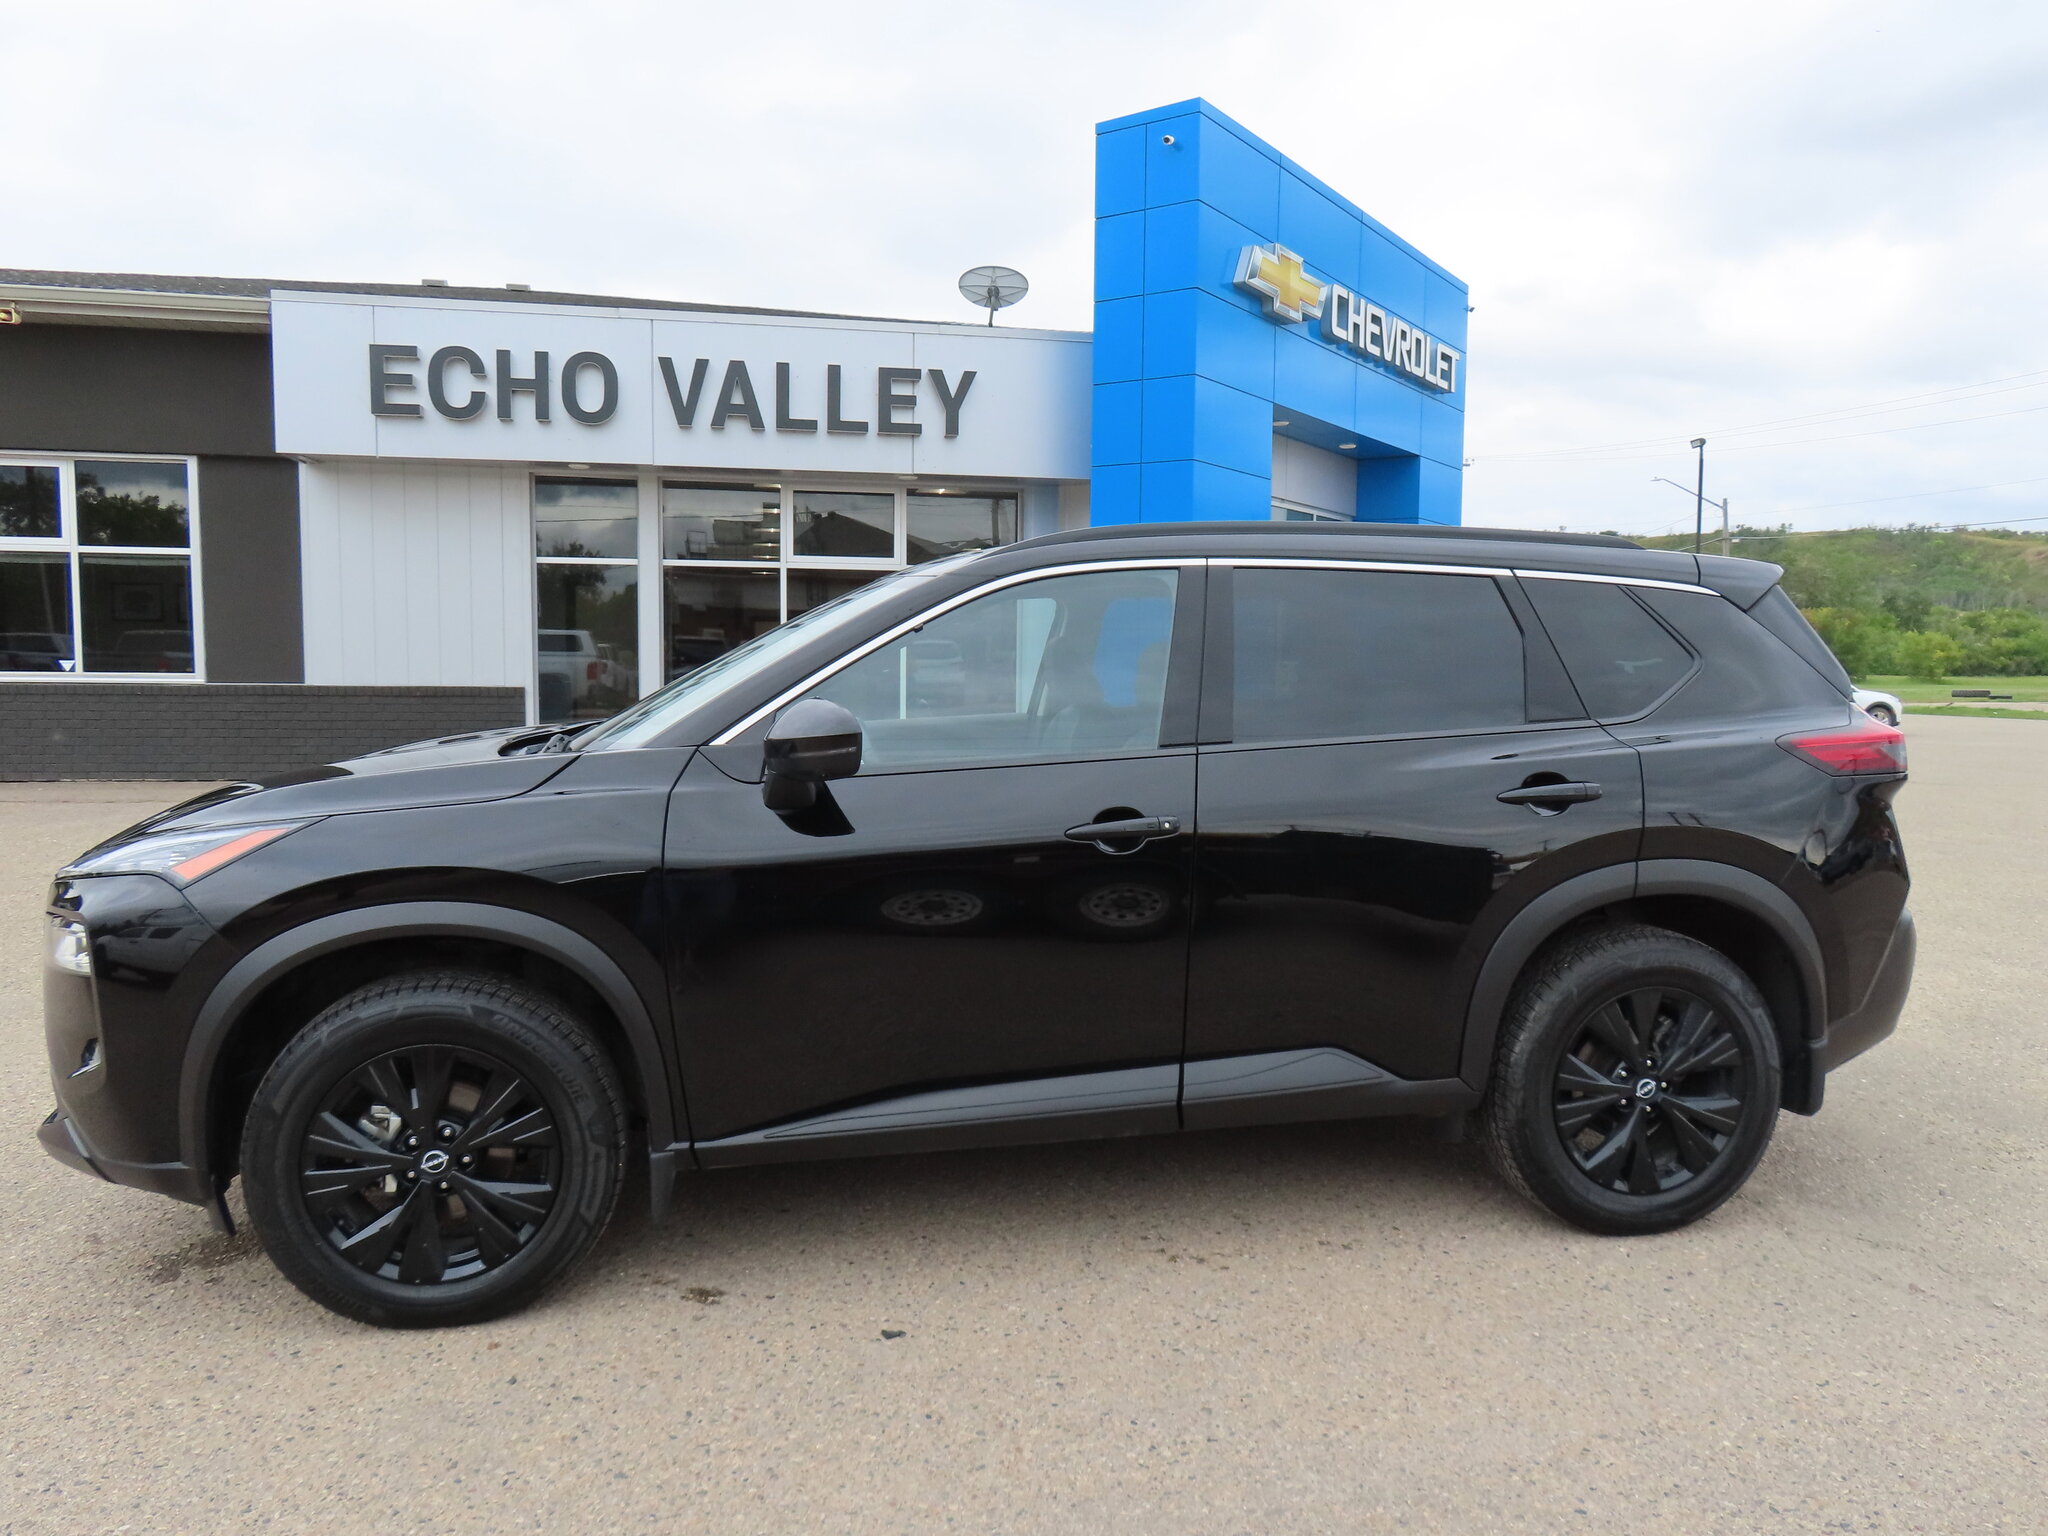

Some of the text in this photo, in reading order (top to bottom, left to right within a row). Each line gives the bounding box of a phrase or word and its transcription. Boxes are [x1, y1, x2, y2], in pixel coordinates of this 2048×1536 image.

[1331, 284, 1460, 393] CHEVROLET
[369, 344, 978, 438] ECHO VALLEY
[492, 1013, 590, 1105] BRIDGTONE
